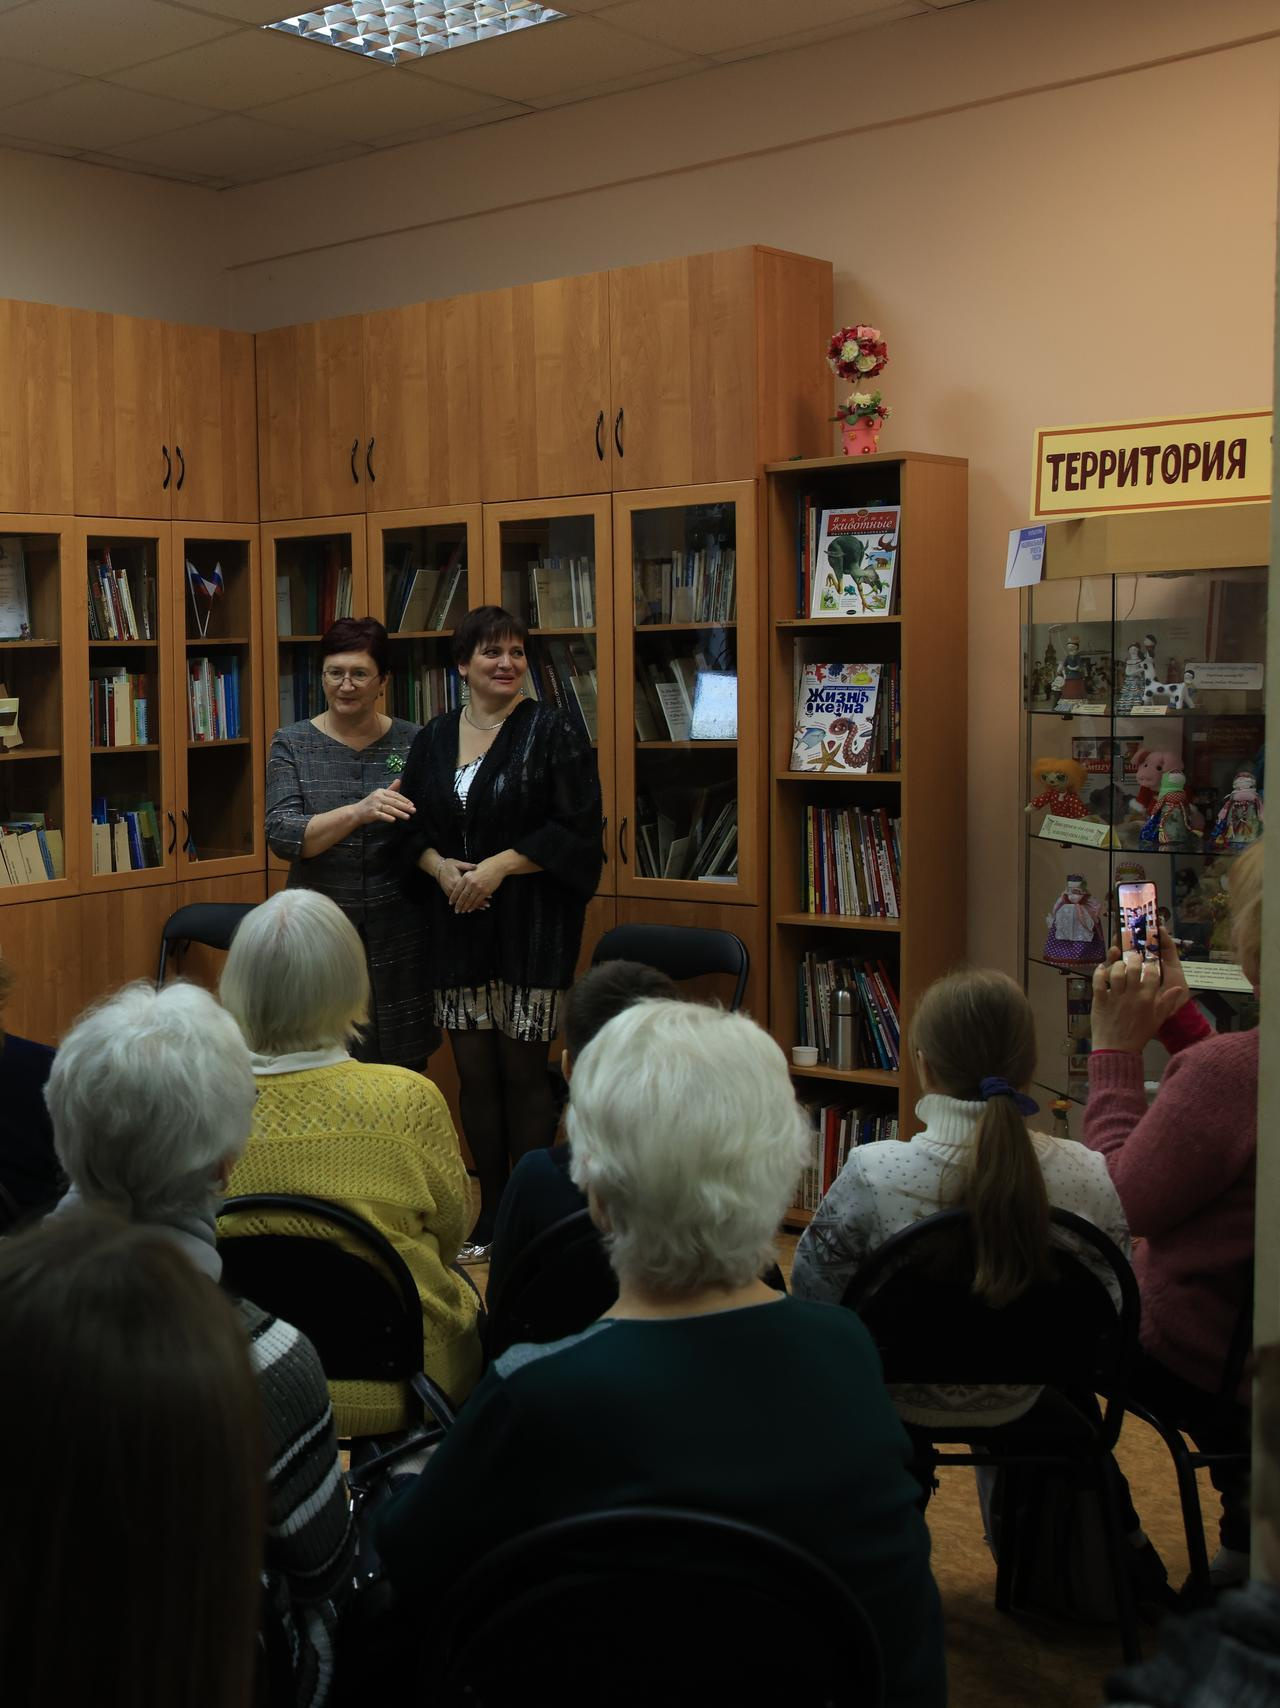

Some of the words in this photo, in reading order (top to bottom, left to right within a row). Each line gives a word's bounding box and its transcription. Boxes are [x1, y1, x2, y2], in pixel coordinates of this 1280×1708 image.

[1046, 438, 1247, 492] ТЕРРИТОРИЯ
[831, 520, 893, 531] животные
[806, 688, 869, 703] Жизнь
